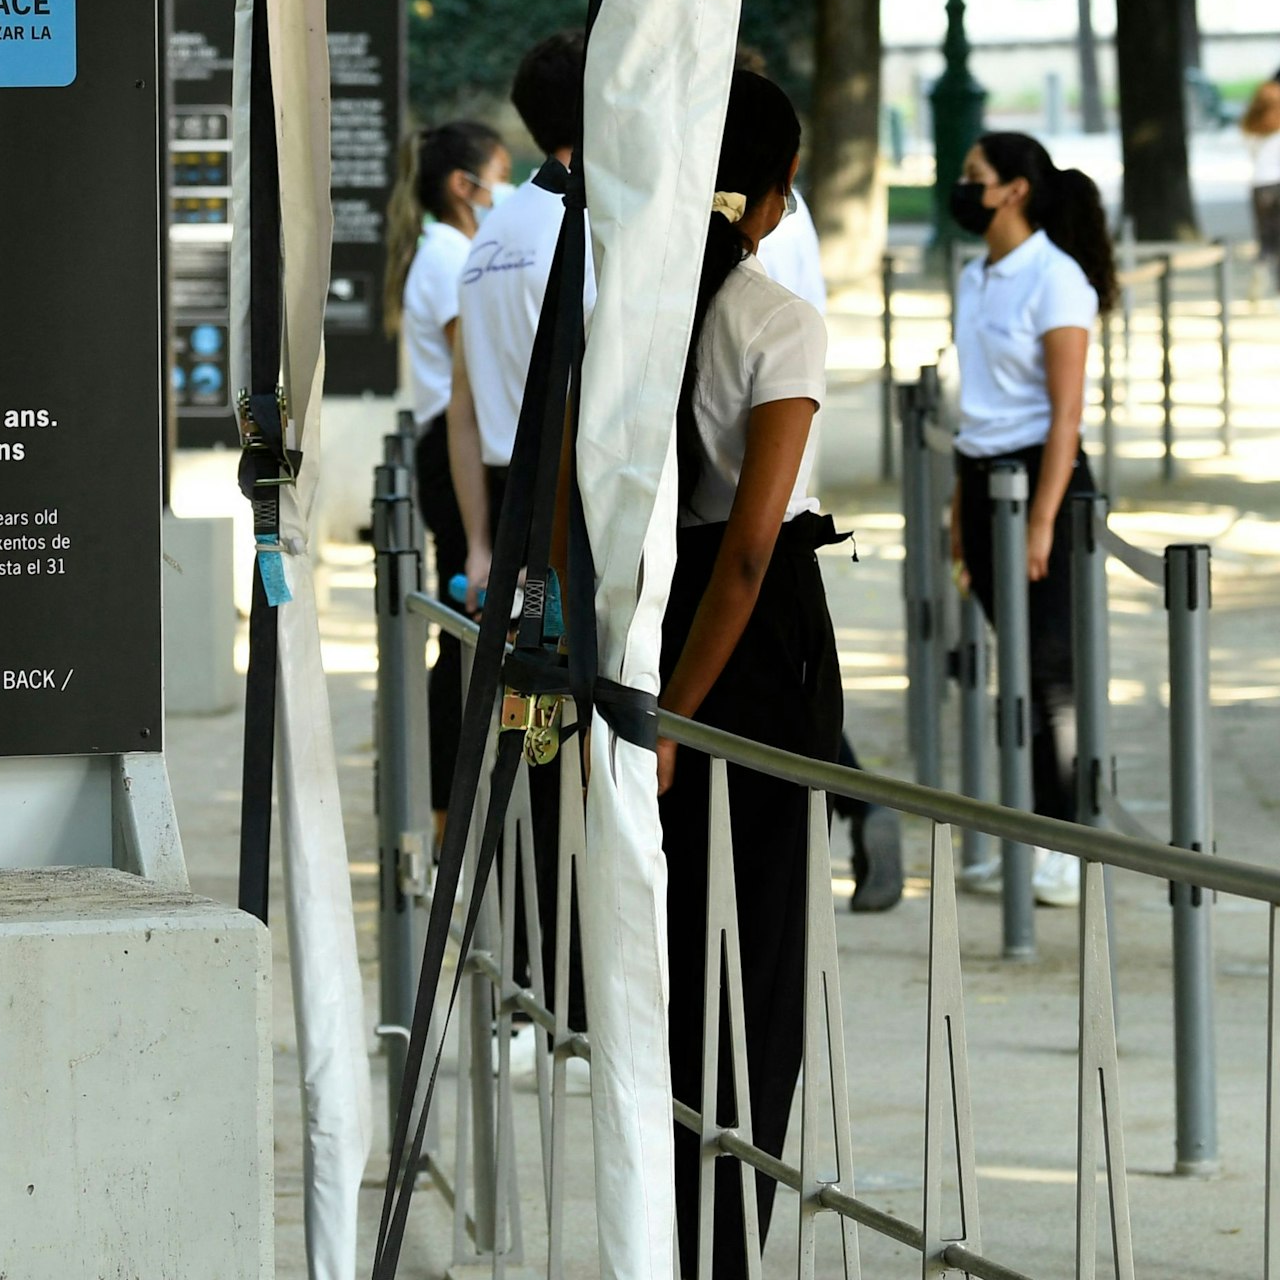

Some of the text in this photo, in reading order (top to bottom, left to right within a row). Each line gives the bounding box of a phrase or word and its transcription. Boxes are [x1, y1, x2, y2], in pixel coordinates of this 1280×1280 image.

[31, 26, 52, 40] LA
[4, 409, 57, 428] ans.
[3, 669, 55, 689] BACK
[61, 669, 73, 691] /
